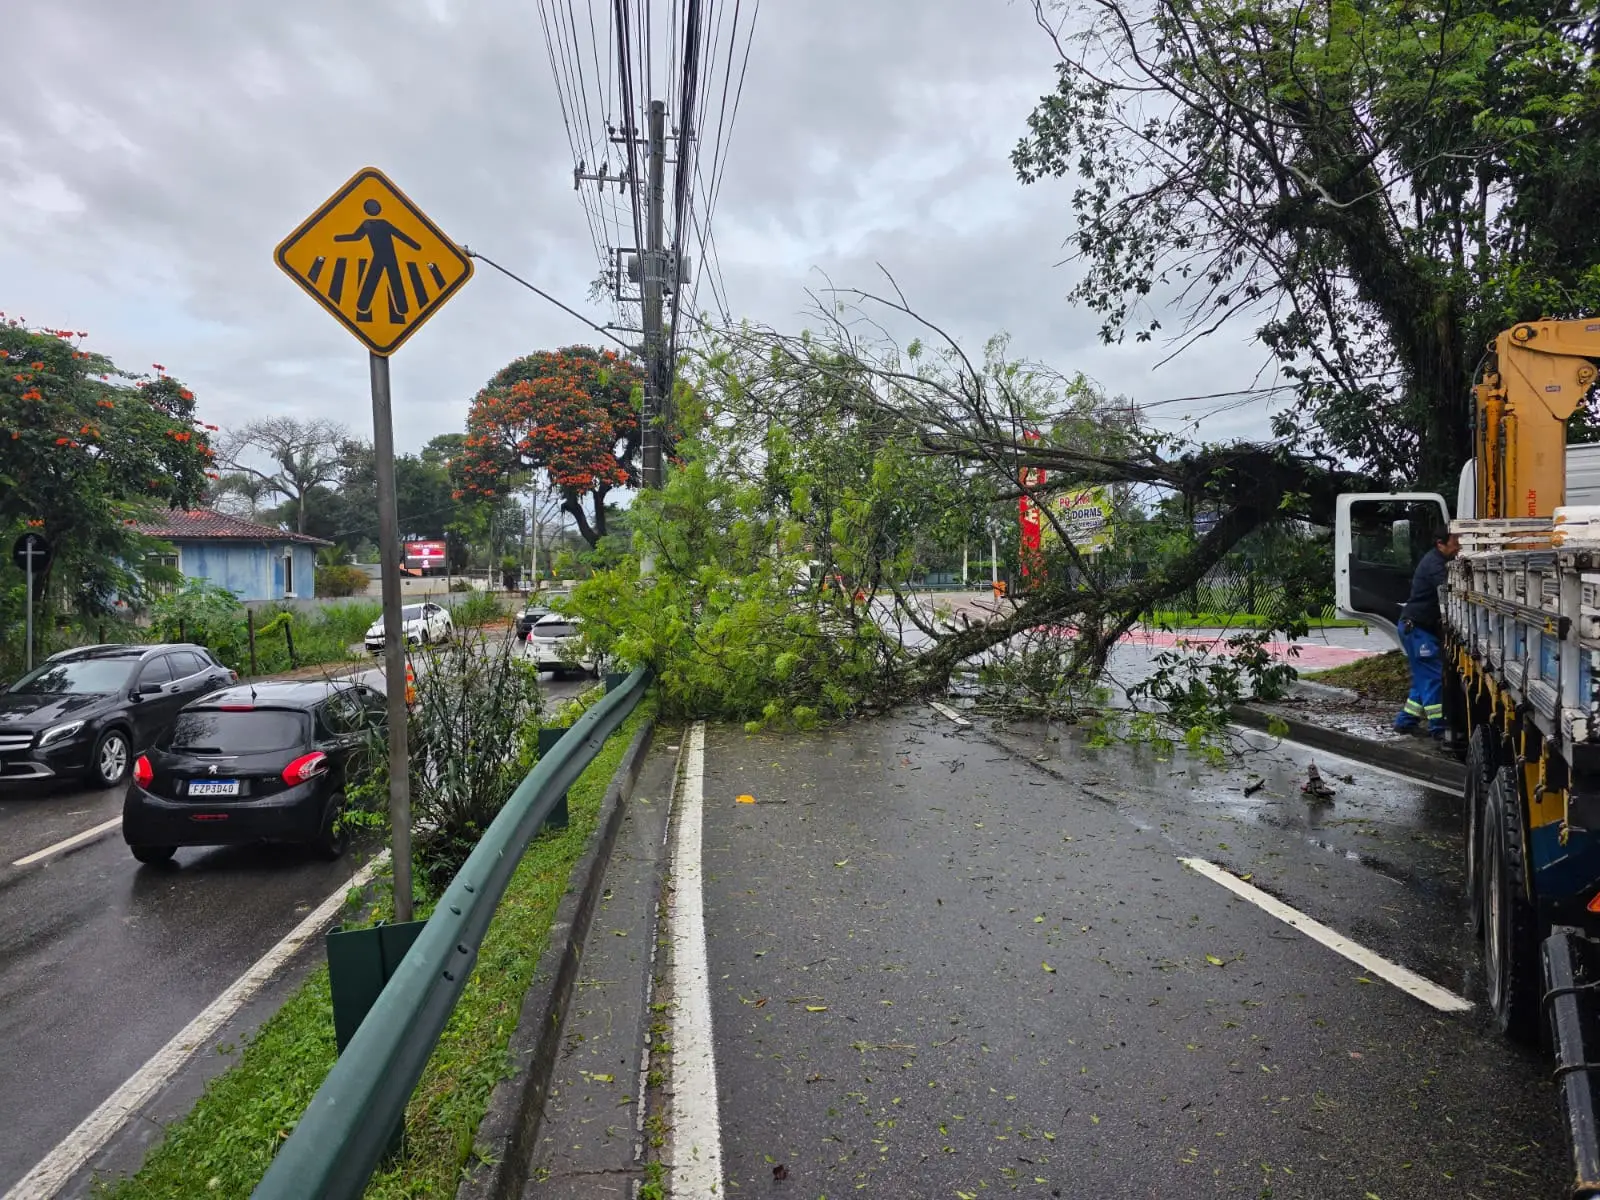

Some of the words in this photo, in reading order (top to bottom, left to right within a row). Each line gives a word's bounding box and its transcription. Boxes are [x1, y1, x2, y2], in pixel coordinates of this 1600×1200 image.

[1526, 488, 1537, 517] om.br
[1072, 507, 1102, 519] DORMS
[193, 784, 234, 794] FZP3D40
